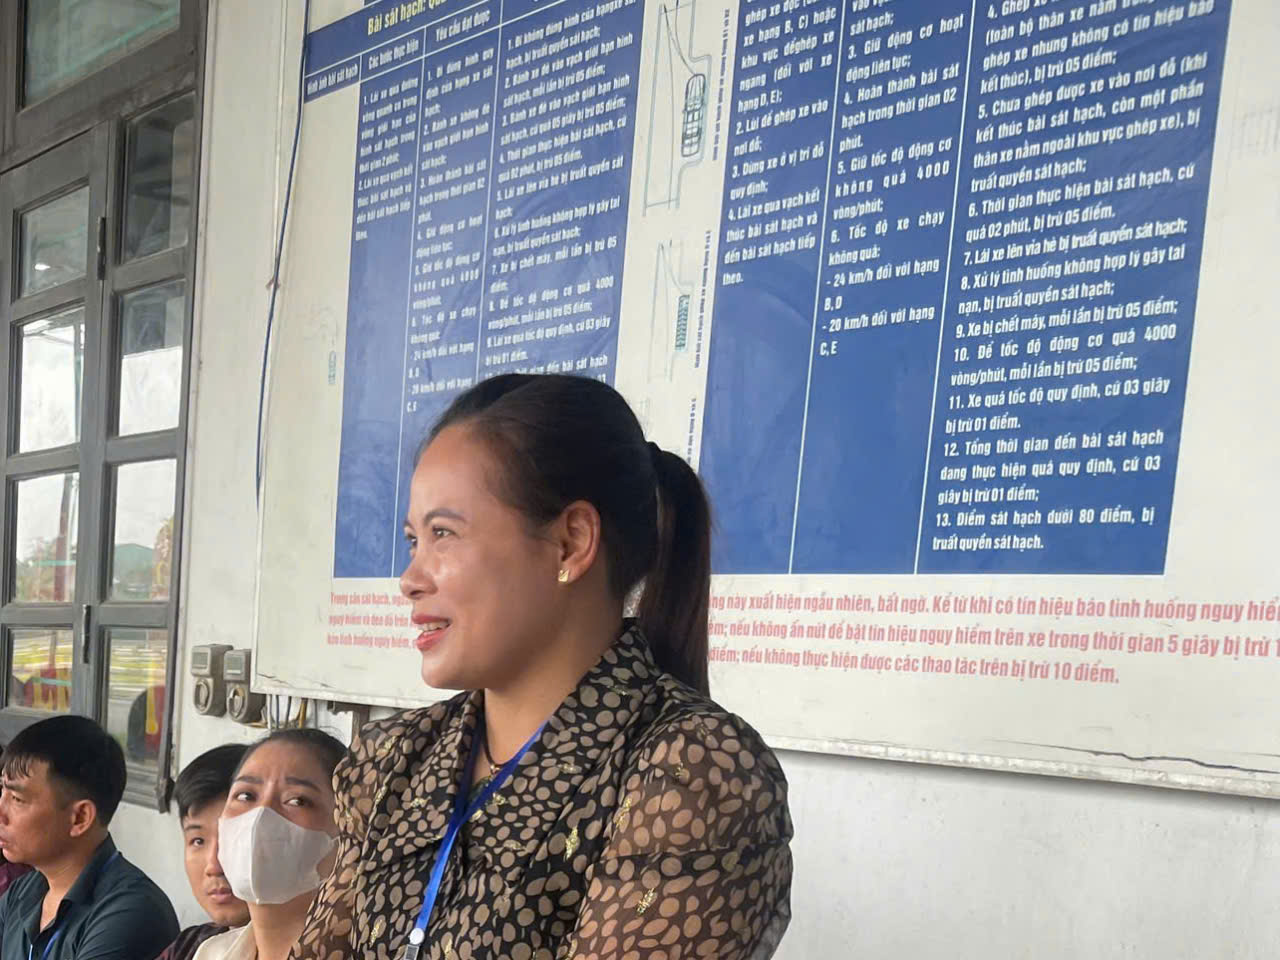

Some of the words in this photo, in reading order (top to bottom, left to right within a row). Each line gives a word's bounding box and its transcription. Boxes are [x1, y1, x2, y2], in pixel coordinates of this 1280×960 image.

[367, 15, 383, 36] Bài
[384, 8, 398, 28] sát
[833, 273, 845, 287] 24
[848, 268, 873, 284] km/h
[914, 259, 939, 276] hạng
[958, 300, 981, 316] nạn,
[983, 295, 994, 313] bị
[996, 289, 1022, 309] truất
[1024, 285, 1059, 306] quyền
[1061, 284, 1079, 300] sát
[1081, 280, 1114, 300] hạch;
[829, 318, 841, 332] 20
[844, 314, 868, 329] km/h
[909, 307, 934, 323] hạng
[956, 324, 965, 338] 9.
[967, 322, 981, 336] Xe
[982, 320, 993, 337] bị
[995, 314, 1019, 333] chết
[1021, 314, 1046, 330] máy,
[1072, 306, 1091, 323] lần
[1092, 306, 1104, 324] bị
[1107, 304, 1123, 320] trừ
[1126, 302, 1140, 318] 05
[954, 347, 969, 362] 10.
[978, 341, 994, 359] Để
[1000, 339, 1018, 357] tốc
[1027, 338, 1041, 356] độ
[1050, 336, 1079, 353] động
[1087, 334, 1103, 347] cơ
[1112, 328, 1135, 346] quá
[1144, 324, 1176, 340] 4000
[1033, 360, 1051, 378] lần
[1053, 361, 1065, 378] bị
[1067, 359, 1083, 374] trừ
[1086, 358, 1100, 373] 05
[949, 395, 964, 409] 11.
[967, 394, 981, 408] Xe
[984, 390, 1005, 408] quá
[1008, 387, 1026, 404] tốc
[1029, 387, 1043, 405] độ
[1047, 388, 1068, 402] quy
[1071, 383, 1100, 401] định,
[1105, 380, 1120, 396] cứ
[1124, 379, 1139, 395] 03
[1143, 377, 1170, 395] giây
[945, 419, 956, 436] bị
[958, 418, 973, 432] trừ
[974, 417, 986, 431] 01
[944, 442, 959, 456] 12.
[965, 438, 991, 456] Tổng
[1023, 437, 1048, 453] gian
[1054, 432, 1076, 449] đến
[1082, 432, 1101, 448] bài
[1107, 431, 1126, 447] sát
[1132, 429, 1164, 448] hạch
[940, 466, 966, 481] đang
[972, 464, 996, 481] thực
[1001, 462, 1026, 480] hiện
[1032, 460, 1053, 477] quá
[1059, 462, 1080, 476] quy
[1086, 458, 1116, 476] định,
[1123, 456, 1139, 472] cứ
[1144, 455, 1160, 470] 03
[938, 489, 960, 505] giây
[962, 488, 973, 505] bị
[974, 488, 990, 502] trừ
[991, 487, 1004, 501] 01
[936, 513, 951, 527] 13.
[957, 509, 985, 526] Điểm
[990, 511, 1008, 525] sát
[1013, 510, 1041, 527] hạch
[1079, 509, 1094, 523] 80
[1100, 504, 1135, 523] điểm,
[1142, 507, 1154, 525] bị
[933, 533, 958, 550] truất
[959, 533, 992, 551] quyền
[993, 534, 1011, 549] sát
[1012, 534, 1043, 552] hạch.
[727, 596, 746, 611] này
[750, 590, 773, 609] xuất
[776, 594, 801, 613] hiện
[836, 594, 874, 612] nhiên,
[877, 592, 898, 612] bất
[954, 595, 967, 613] từ
[969, 595, 992, 613] khi
[995, 596, 1013, 614] có
[1039, 597, 1073, 619] hiệu
[1144, 597, 1196, 622] huống
[1201, 604, 1244, 623] nguy
[1247, 597, 1280, 621] hiể
[730, 618, 750, 635] nếu
[752, 620, 787, 639] không
[807, 622, 825, 638] nút
[828, 620, 842, 639] để
[846, 624, 865, 644] bật
[888, 624, 916, 646] hiệu
[920, 629, 952, 646] nguy
[955, 625, 991, 645] hiểm
[994, 628, 1023, 646] trên
[1027, 632, 1045, 647] xe
[1049, 630, 1089, 651] trong
[1128, 633, 1163, 654] gian
[1168, 634, 1178, 653] 5
[1182, 634, 1219, 657] giây
[1223, 635, 1239, 660] bị
[1244, 636, 1269, 657] trừ
[742, 645, 762, 663] nếu
[765, 648, 800, 667] không
[803, 650, 828, 670] thực
[831, 651, 858, 672] hiện
[894, 654, 919, 672] các
[922, 656, 952, 673] thao
[955, 657, 976, 674] tác
[979, 658, 1008, 676] trên
[1011, 659, 1025, 681] bị
[1029, 660, 1049, 679] trừ
[1055, 662, 1072, 680] 10
